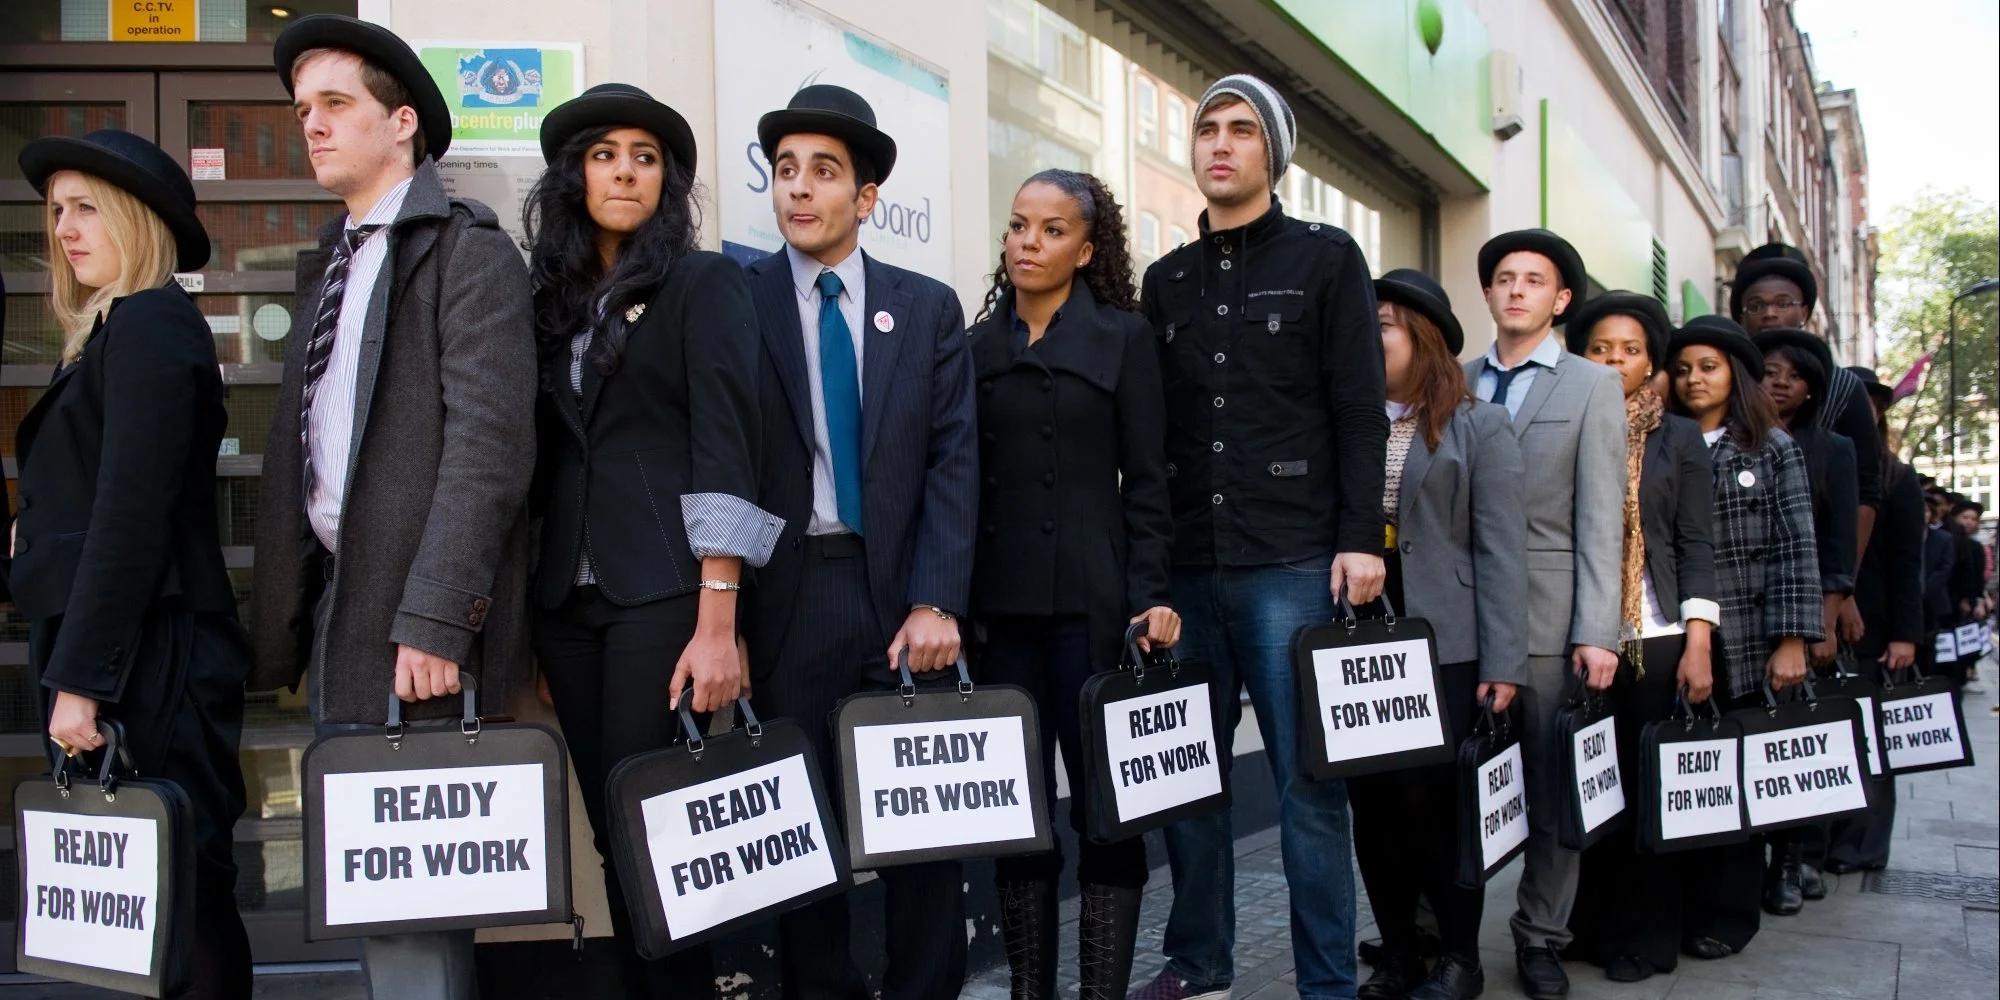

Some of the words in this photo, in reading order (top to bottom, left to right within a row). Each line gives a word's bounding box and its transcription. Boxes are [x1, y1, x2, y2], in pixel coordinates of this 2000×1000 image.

[127, 25, 181, 36] operation
[149, 14, 160, 23] in
[450, 111, 543, 133] bcentreplu
[474, 160, 498, 169] times
[177, 277, 194, 288] PULL
[1341, 653, 1406, 685] READY
[1129, 699, 1187, 739] READY
[1331, 702, 1370, 730] FOR
[1372, 694, 1431, 723] WORK
[1882, 703, 1933, 726] READY
[894, 732, 988, 767] READY
[1583, 730, 1606, 762] READY
[1765, 733, 1827, 763] READY
[1884, 736, 1904, 751] OR
[1906, 728, 1953, 747] WORK
[1120, 755, 1157, 787] FOR
[1158, 741, 1210, 776] WORK
[1488, 758, 1513, 796] READY
[1678, 750, 1720, 774] READY
[875, 787, 929, 817] FOR
[935, 779, 1018, 811] WORK
[1582, 777, 1597, 804] FOR
[1596, 765, 1618, 794] WORK
[1668, 790, 1692, 811] FOR
[1695, 786, 1733, 808] WORK
[1755, 776, 1791, 799] FOR
[1794, 766, 1852, 792] WORK
[375, 782, 497, 822] READY
[686, 776, 781, 835] READY
[1485, 810, 1500, 839] FOR
[1501, 793, 1524, 826] WORK
[54, 829, 128, 868] READY
[345, 847, 412, 882] FOR
[423, 839, 530, 876] WORK
[671, 852, 734, 896] FOR
[737, 822, 817, 874] WORK
[37, 885, 74, 920] FOR
[81, 890, 145, 930] WORK
